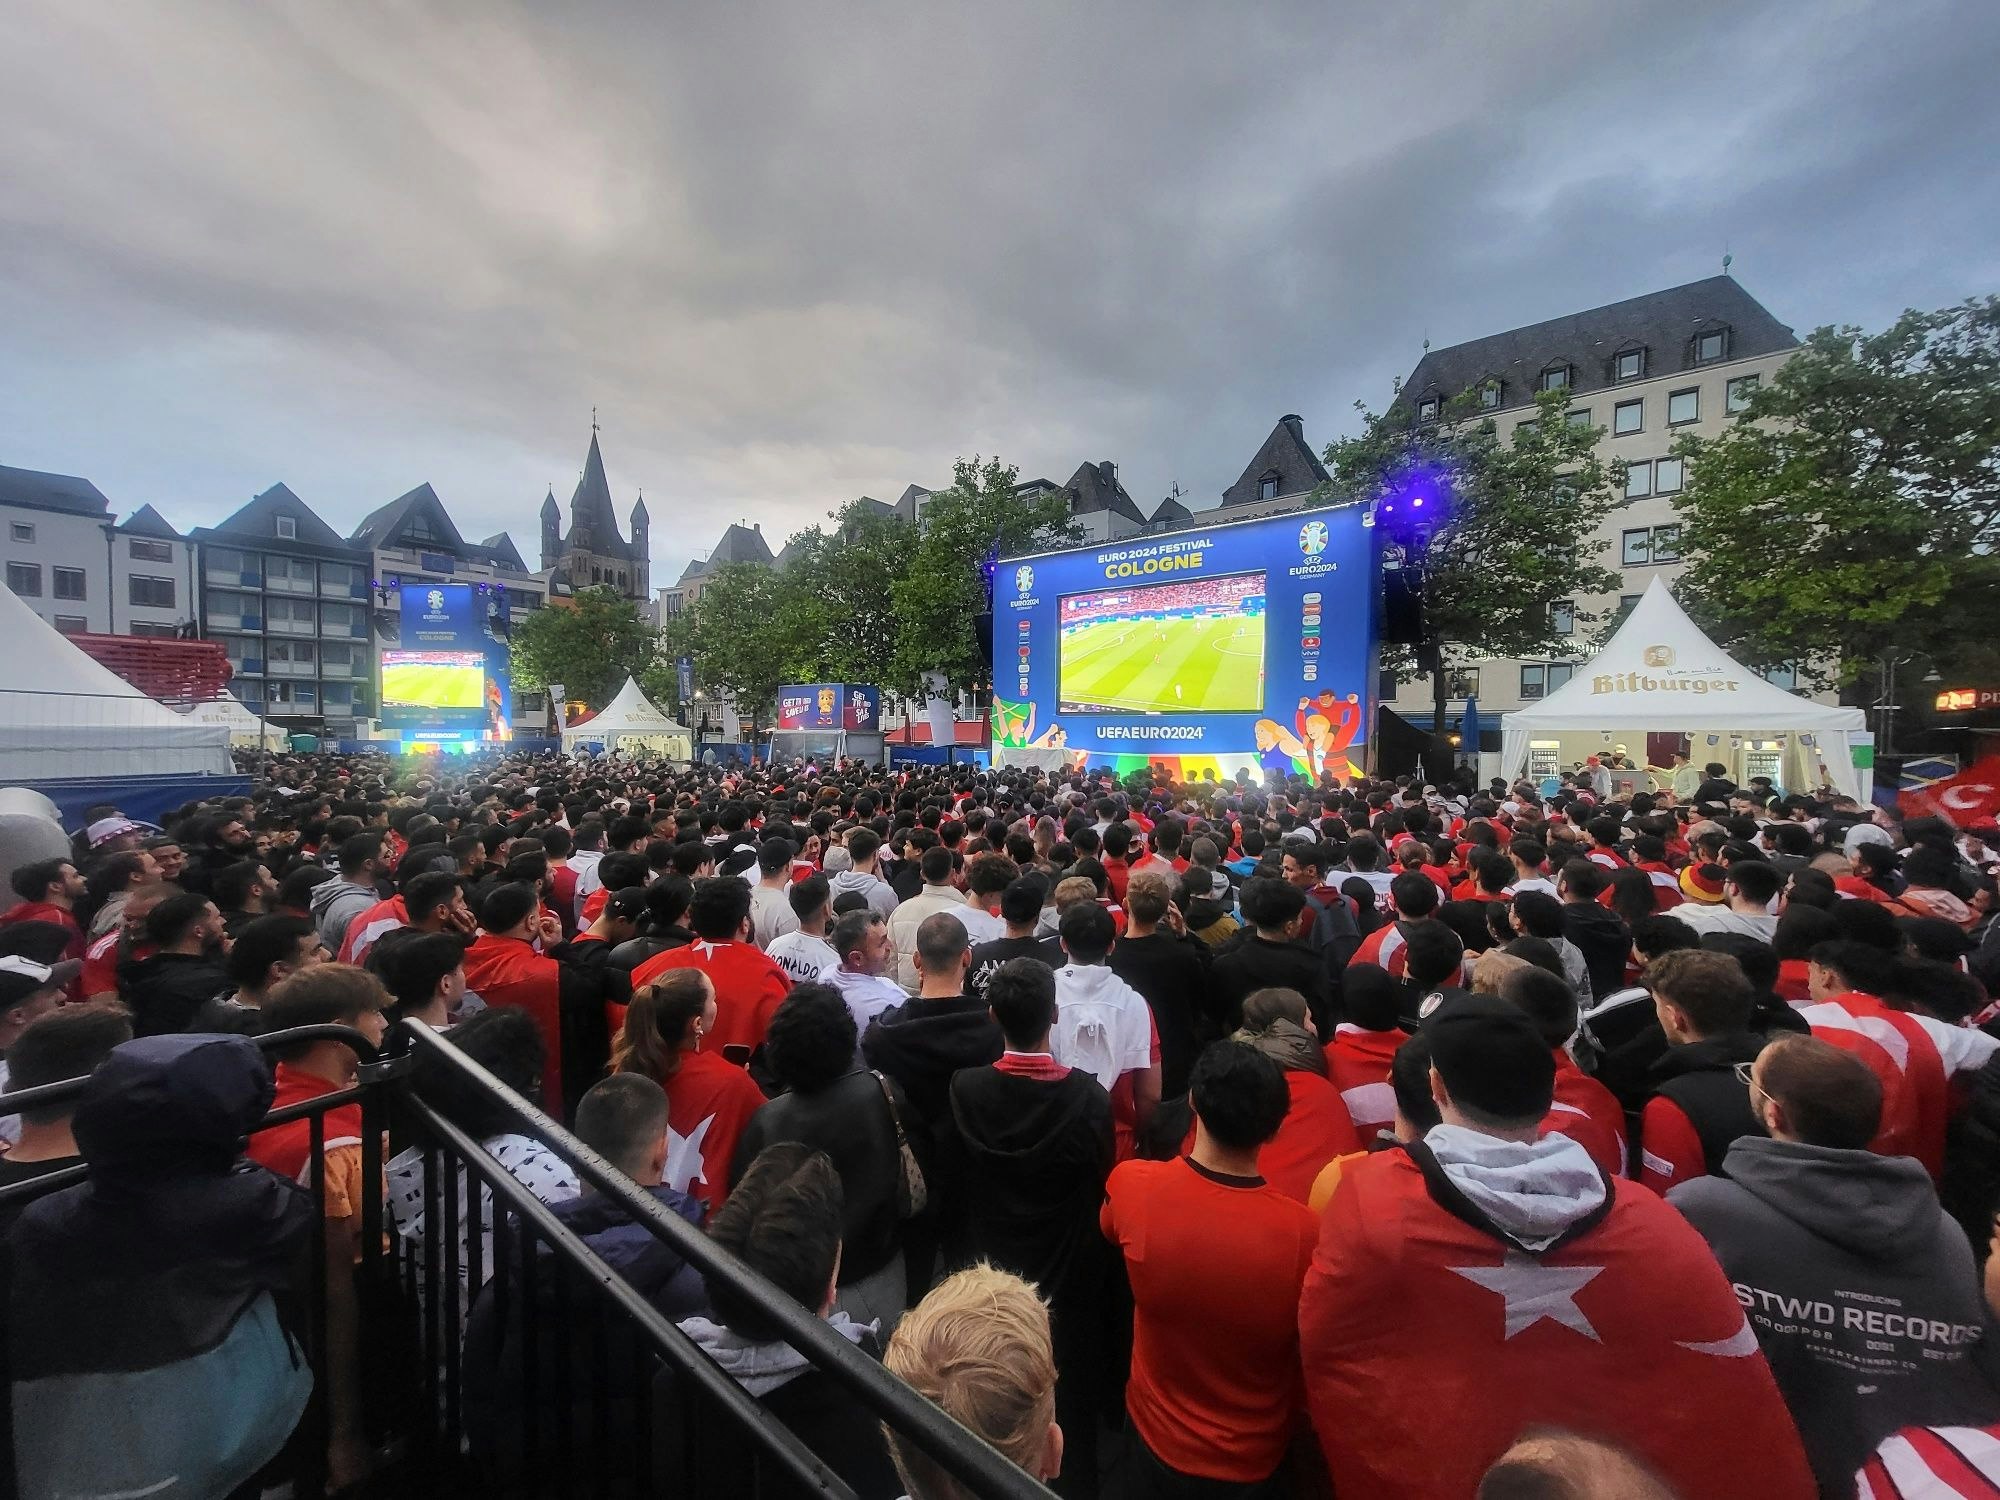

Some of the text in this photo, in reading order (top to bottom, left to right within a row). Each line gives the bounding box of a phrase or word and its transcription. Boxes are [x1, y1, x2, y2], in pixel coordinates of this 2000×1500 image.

[1098, 539, 1214, 563] EURO 2024 FESTIVAL
[1105, 552, 1203, 578] COLOGNE
[1289, 563, 1337, 576] EURO2024
[1590, 671, 1740, 695] Bitburger
[1096, 726, 1204, 739] UEFAEURO2024
[1835, 1290, 1902, 1307] INTRODUCING
[1732, 1283, 1983, 1345] STWD RECORDS
